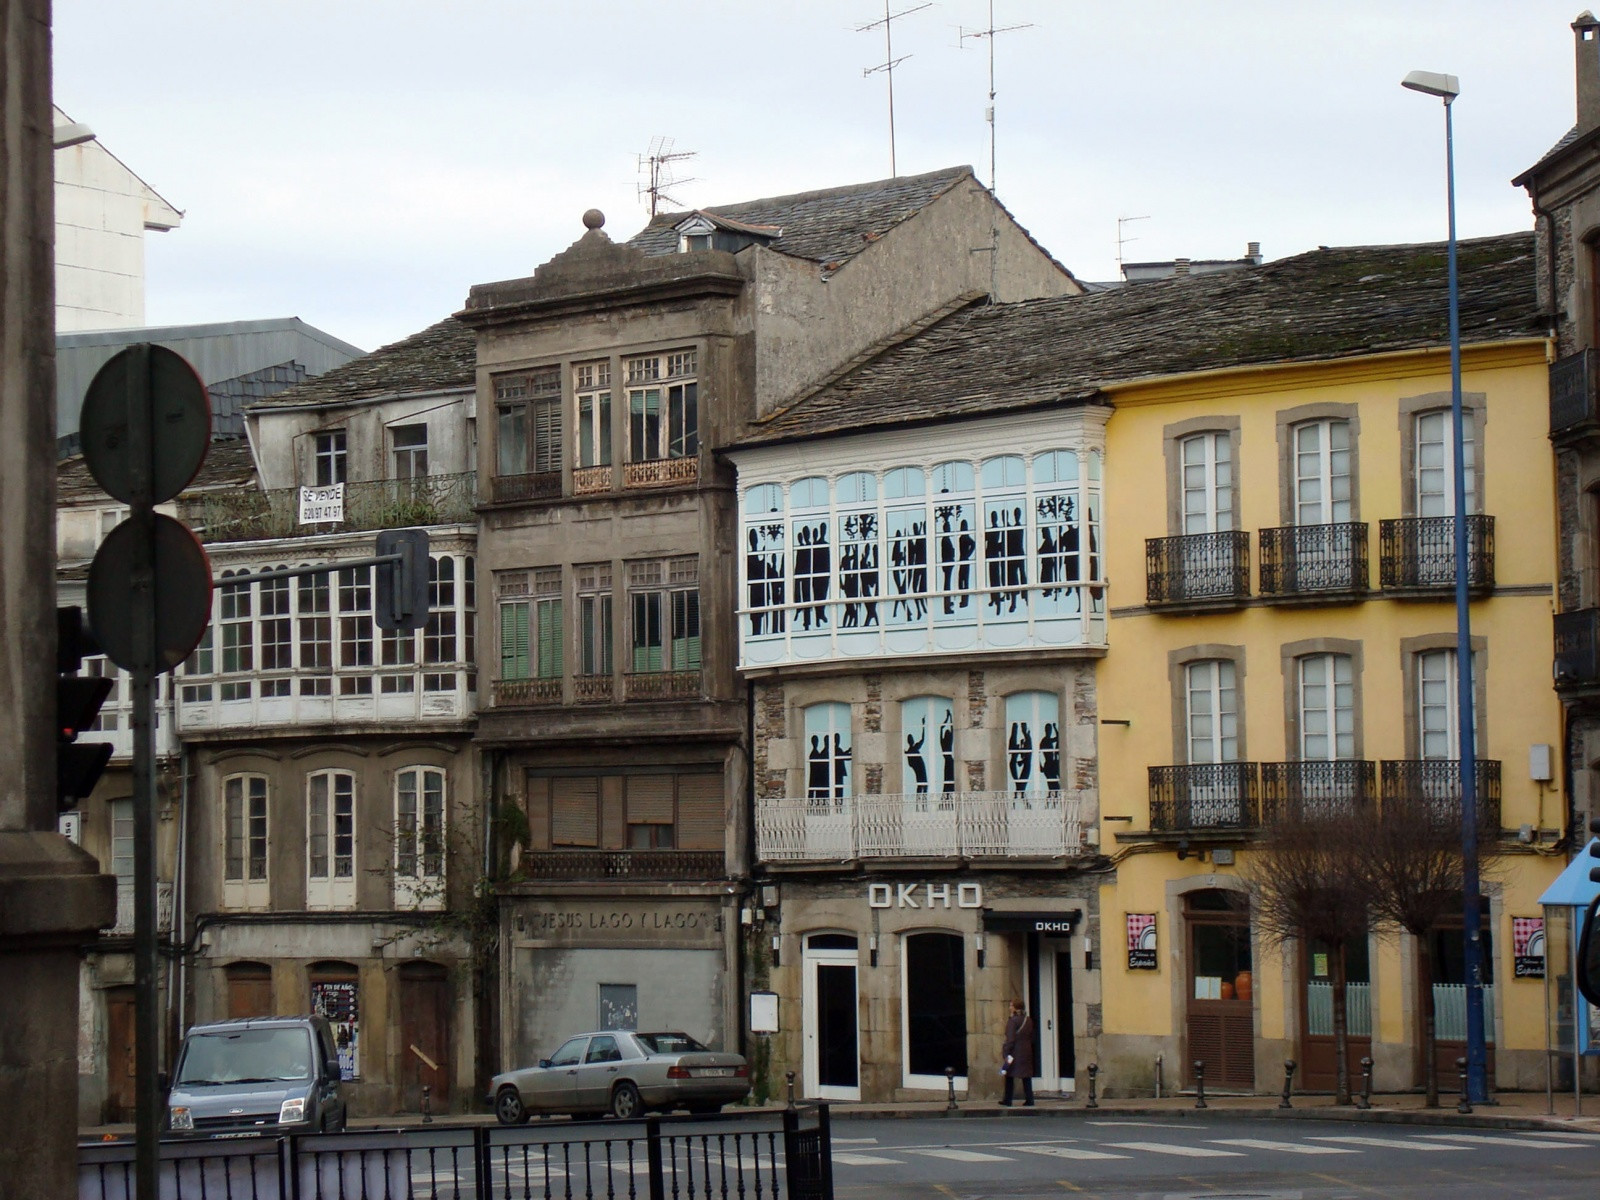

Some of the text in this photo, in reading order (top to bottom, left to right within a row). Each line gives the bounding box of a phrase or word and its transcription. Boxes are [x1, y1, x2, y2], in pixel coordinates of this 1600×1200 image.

[303, 488, 341, 502] SE VENDE
[869, 883, 983, 908] OKHO
[589, 912, 633, 929] LAGO
[641, 912, 648, 928] Y
[1035, 922, 1070, 931] OKHO
[1129, 957, 1155, 968] España
